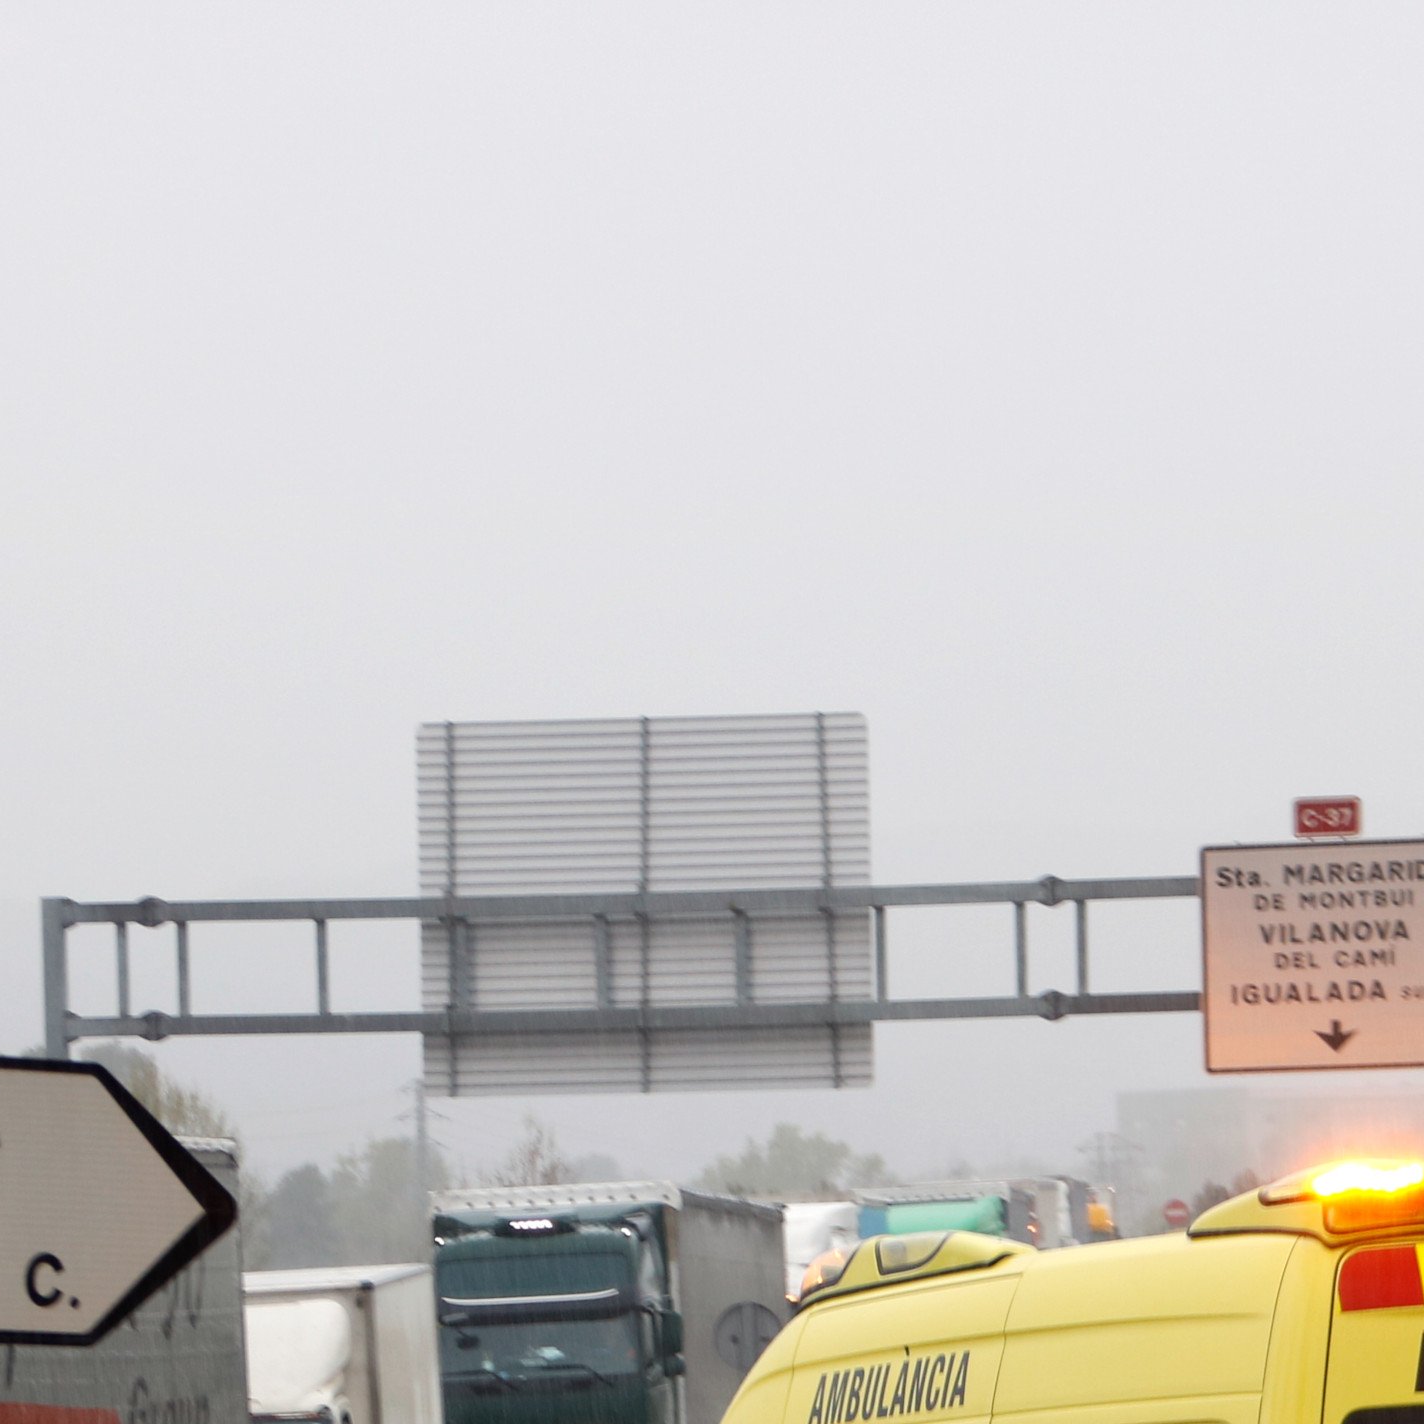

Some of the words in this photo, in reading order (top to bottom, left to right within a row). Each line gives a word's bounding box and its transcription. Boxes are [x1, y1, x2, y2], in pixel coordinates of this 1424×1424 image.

[1301, 806, 1353, 829] C-37
[1215, 866, 1271, 889] Sta.
[1253, 892, 1285, 912] DE
[1299, 888, 1416, 909] MONTBUI
[1258, 919, 1411, 945] VILANOVA
[1274, 951, 1322, 970] DEL
[1333, 944, 1398, 969] CAMÍ
[1229, 979, 1388, 1005] IGUALADA
[25, 1252, 82, 1310] C.
